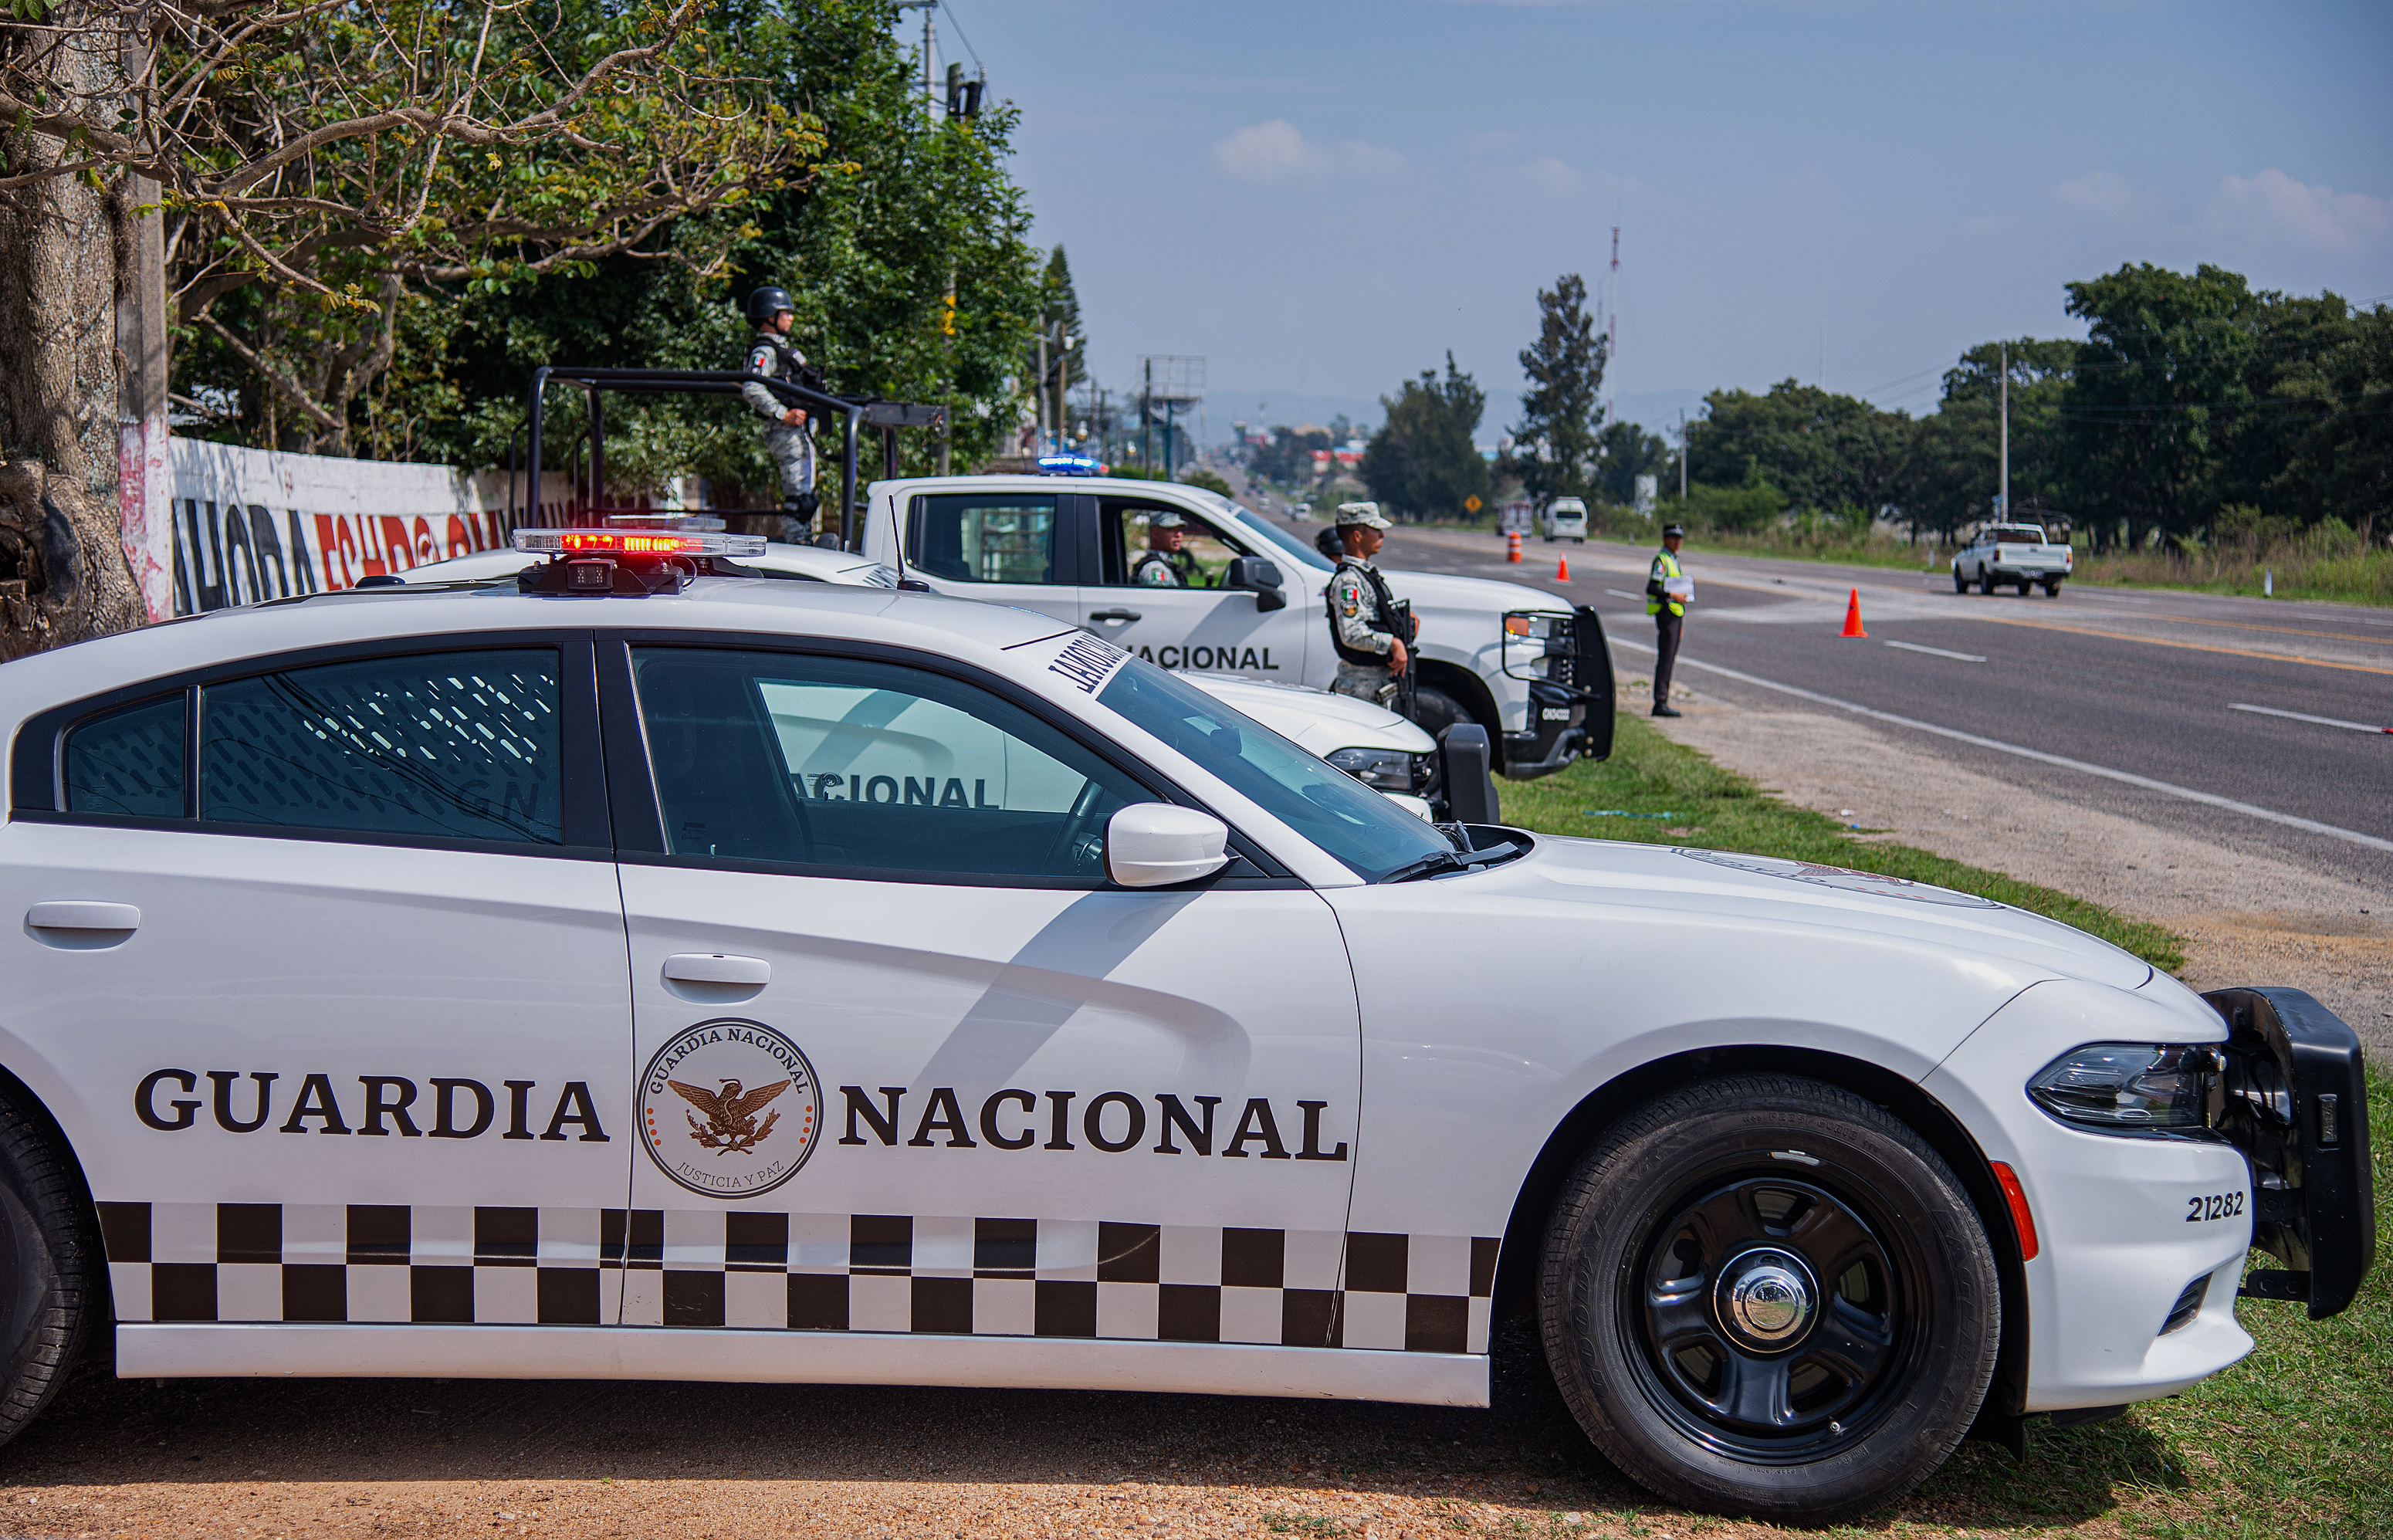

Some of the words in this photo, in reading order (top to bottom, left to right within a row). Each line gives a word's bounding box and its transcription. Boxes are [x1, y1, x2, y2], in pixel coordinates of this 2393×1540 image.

[1125, 645, 1280, 671] ACIONAL
[650, 1030, 723, 1095] GUARDIA
[727, 1028, 809, 1095] NACIONAL
[134, 1068, 611, 1142] GUARDIA
[839, 1085, 1348, 1162] NACIONAL
[676, 1162, 742, 1188] JUSTICIA
[744, 1175, 753, 1186] Y
[756, 1160, 784, 1182] PAZ
[2186, 1191, 2244, 1223] 21282
